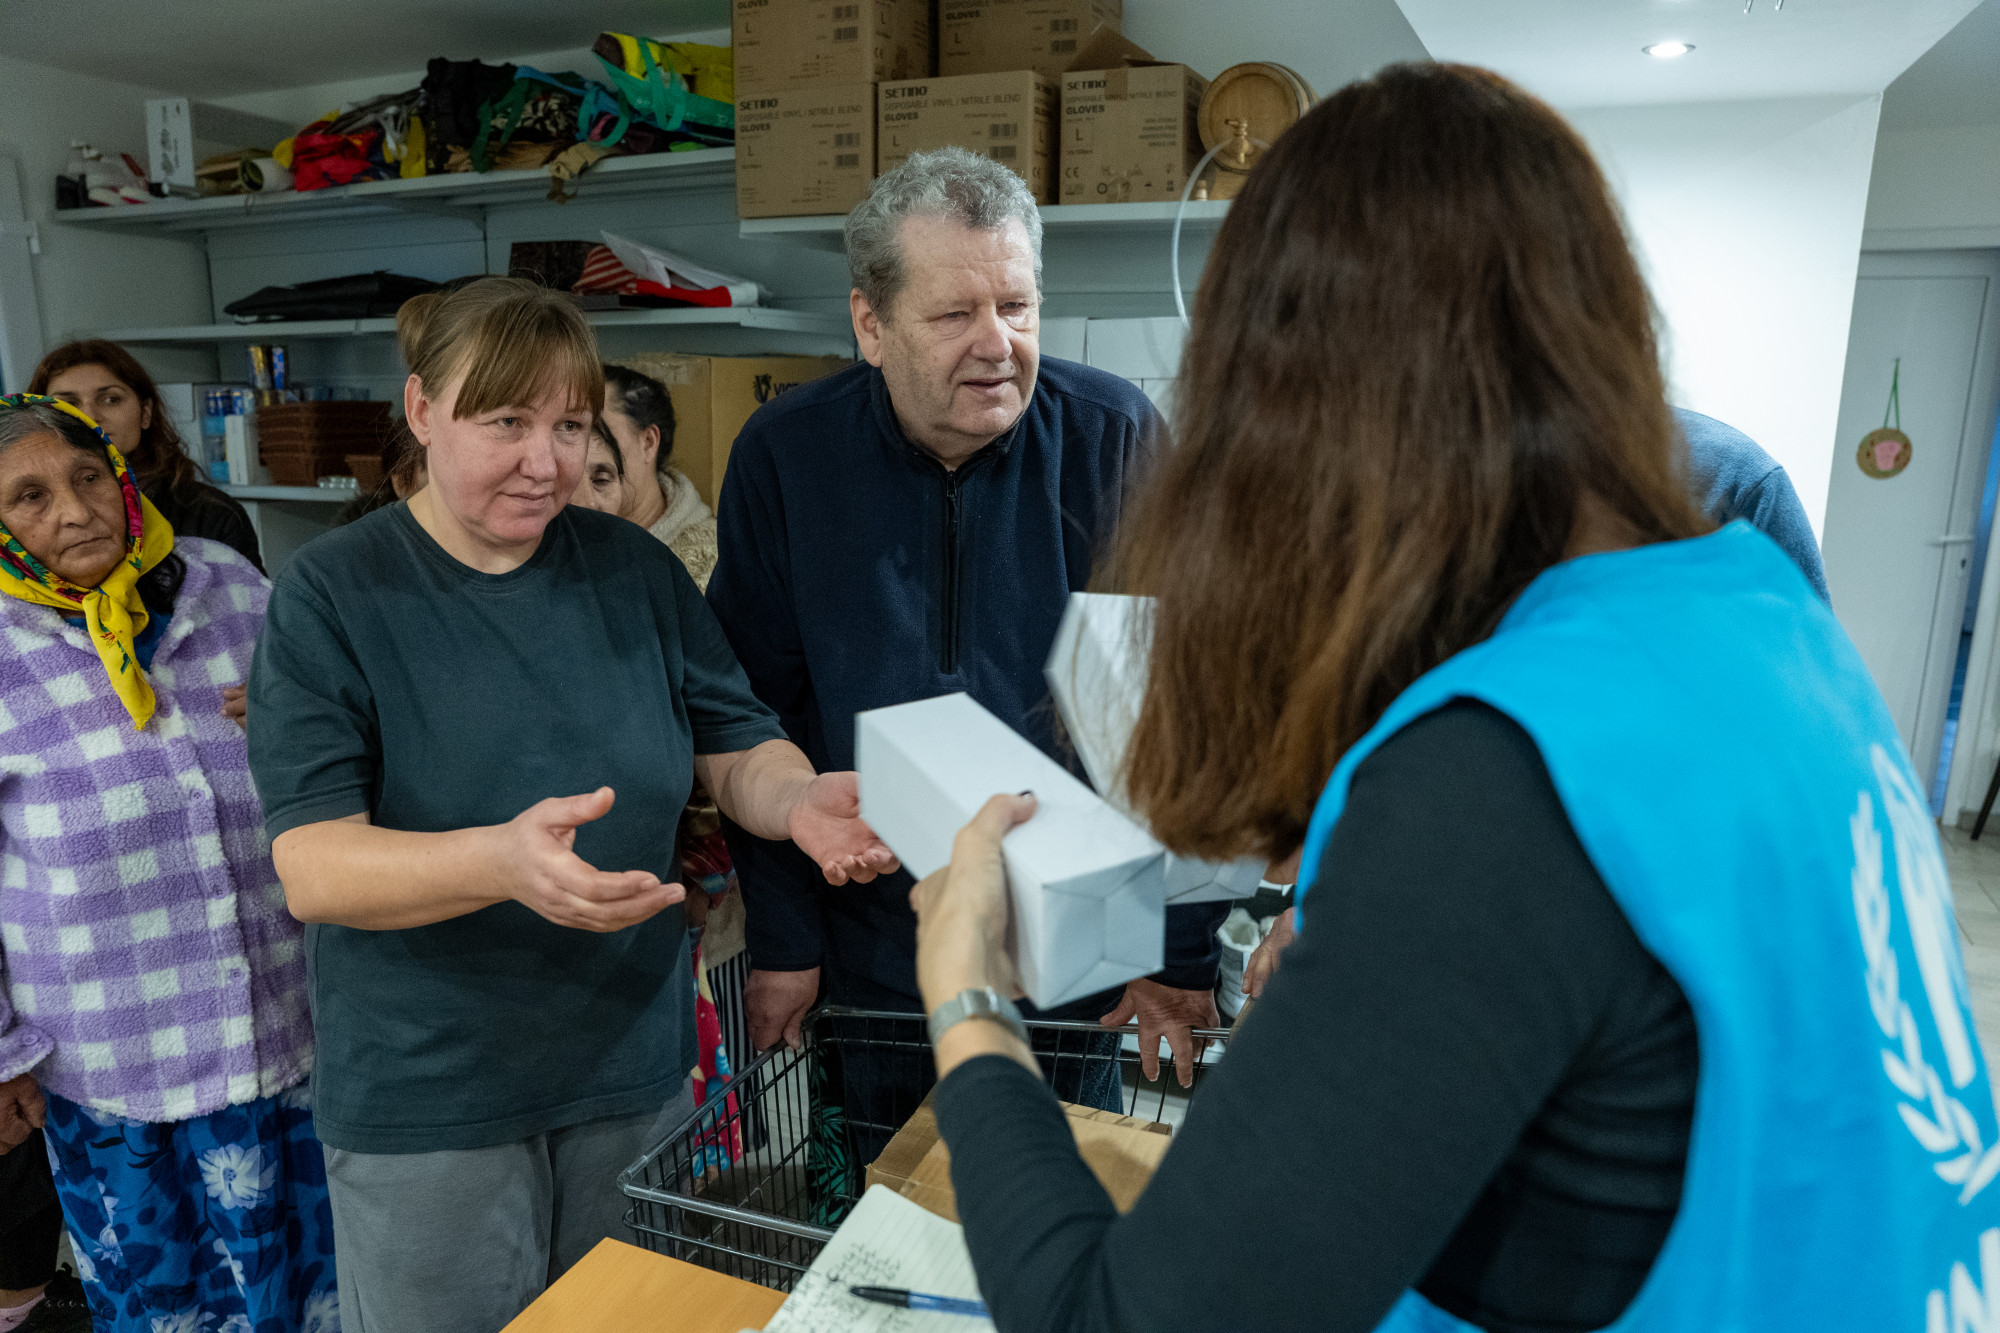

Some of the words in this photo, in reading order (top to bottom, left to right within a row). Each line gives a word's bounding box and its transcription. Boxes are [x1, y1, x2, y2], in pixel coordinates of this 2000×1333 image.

[946, 10, 980, 20] GLOVES
[745, 22, 752, 33] L
[954, 33, 961, 44] L
[885, 85, 928, 99] SETINO
[960, 95, 990, 105] NITRILE
[993, 94, 1021, 104] BLEND
[1066, 104, 1105, 115] GLOVES
[884, 112, 919, 122] GLOVES
[740, 123, 770, 133] GLOVES
[1076, 128, 1083, 141] L
[892, 135, 900, 147] L
